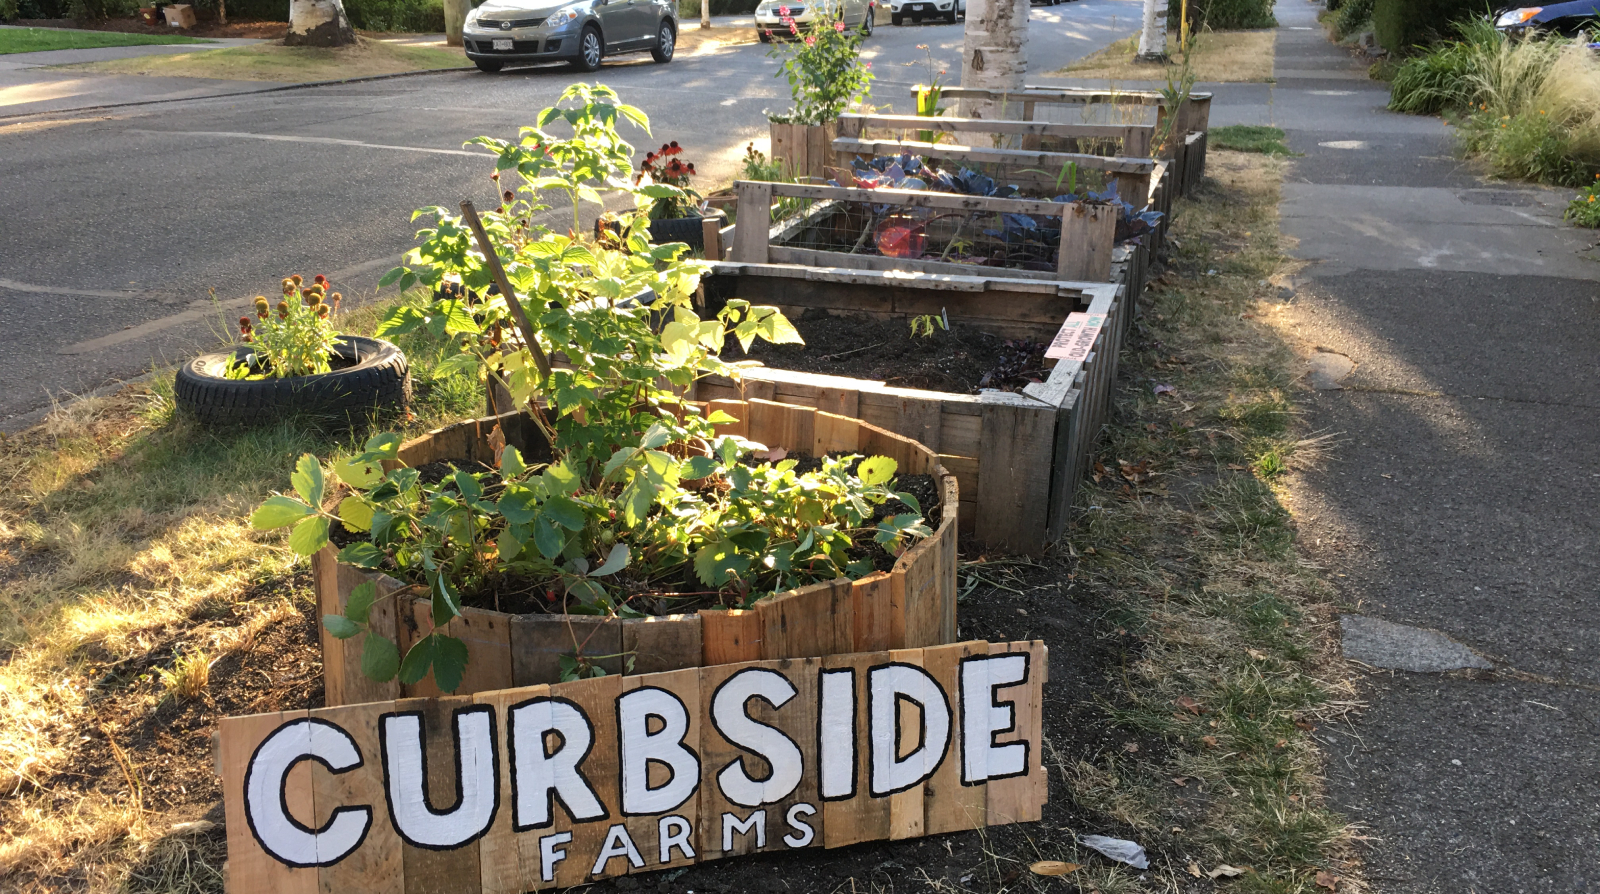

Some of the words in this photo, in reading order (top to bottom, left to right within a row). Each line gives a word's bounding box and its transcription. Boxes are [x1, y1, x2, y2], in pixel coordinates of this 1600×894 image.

[1052, 328, 1076, 348] PROTECT
[244, 653, 1030, 867] CURBSIDE
[538, 802, 817, 881] FARMS
